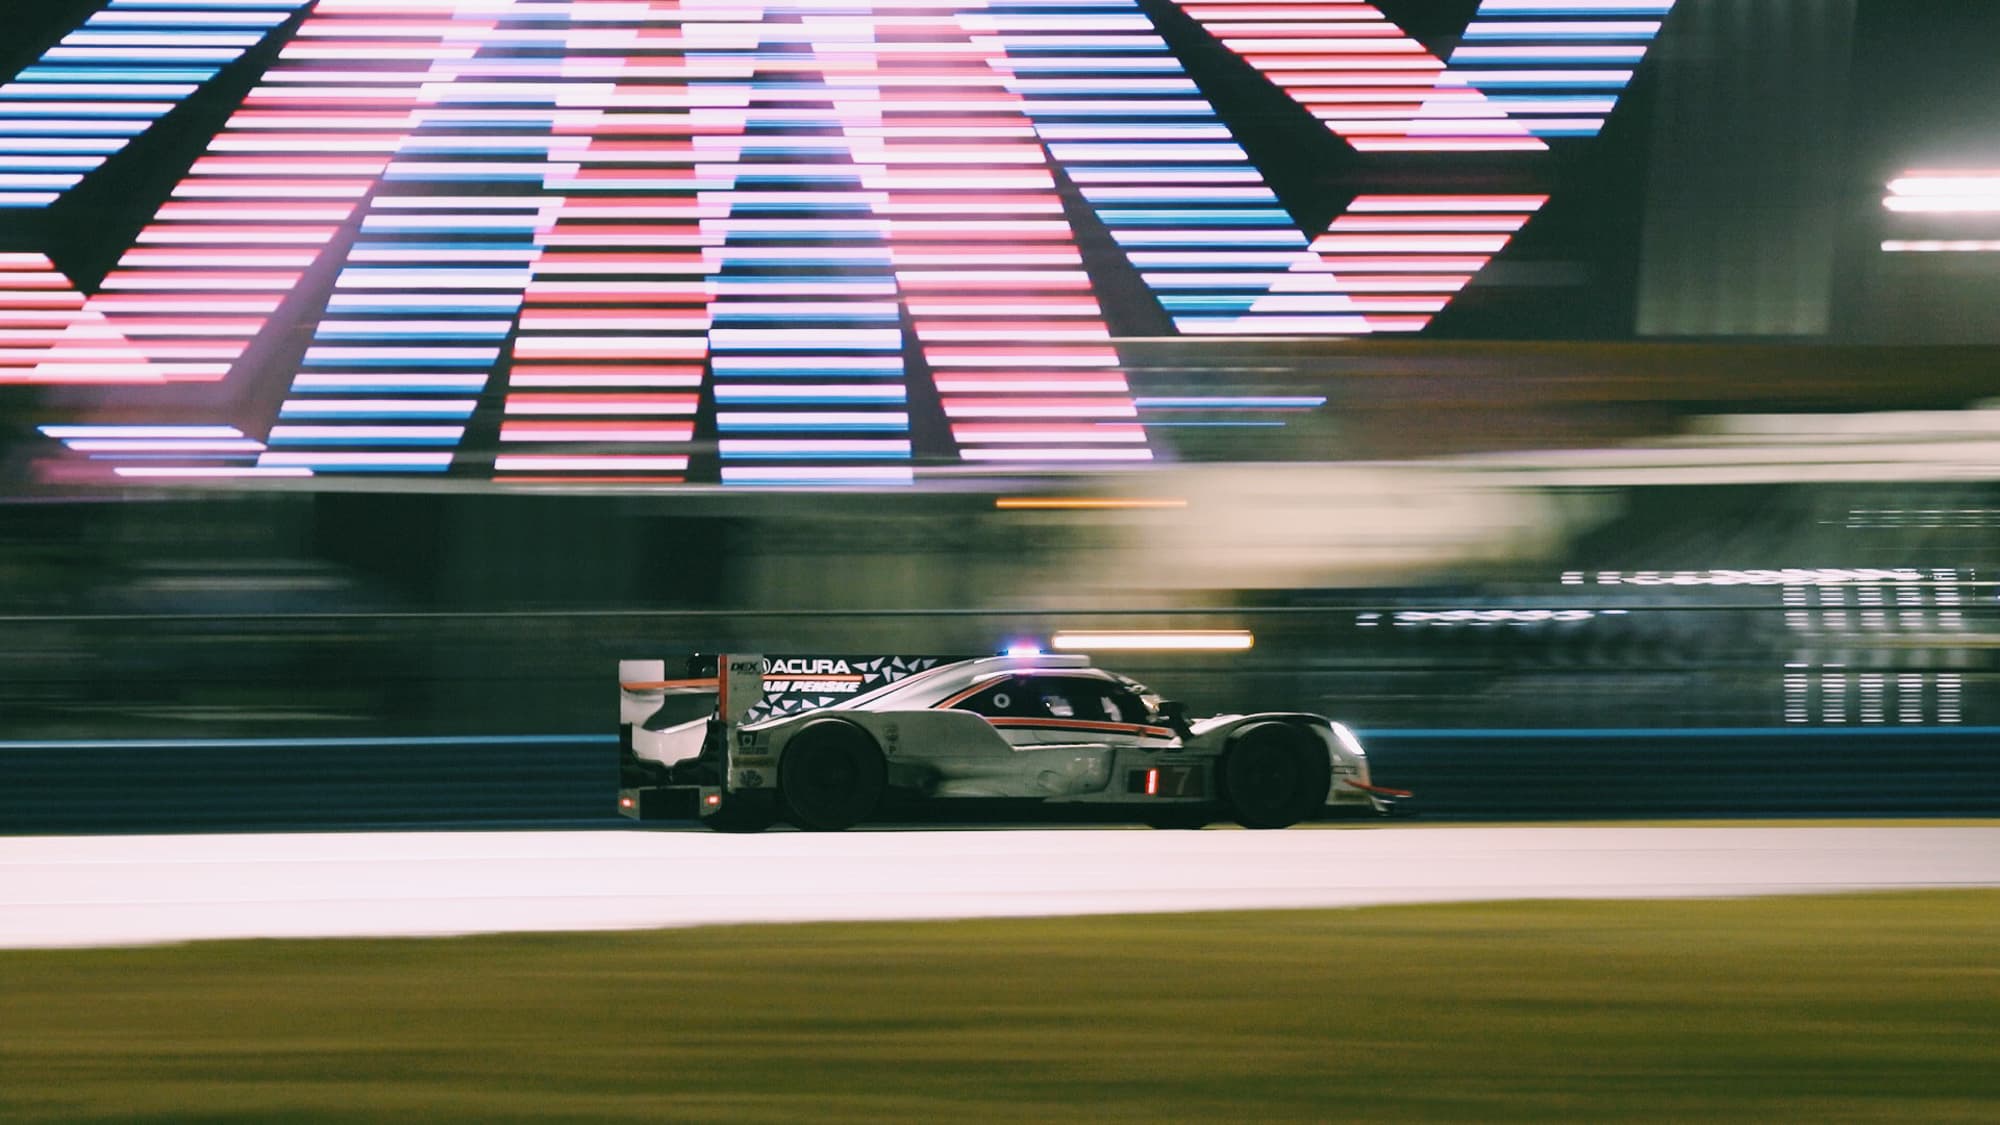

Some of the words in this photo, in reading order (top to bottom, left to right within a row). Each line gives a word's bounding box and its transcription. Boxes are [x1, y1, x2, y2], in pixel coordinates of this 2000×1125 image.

[771, 659, 851, 674] ACURA
[790, 681, 860, 692] PENSKE
[1173, 767, 1192, 795] 7
